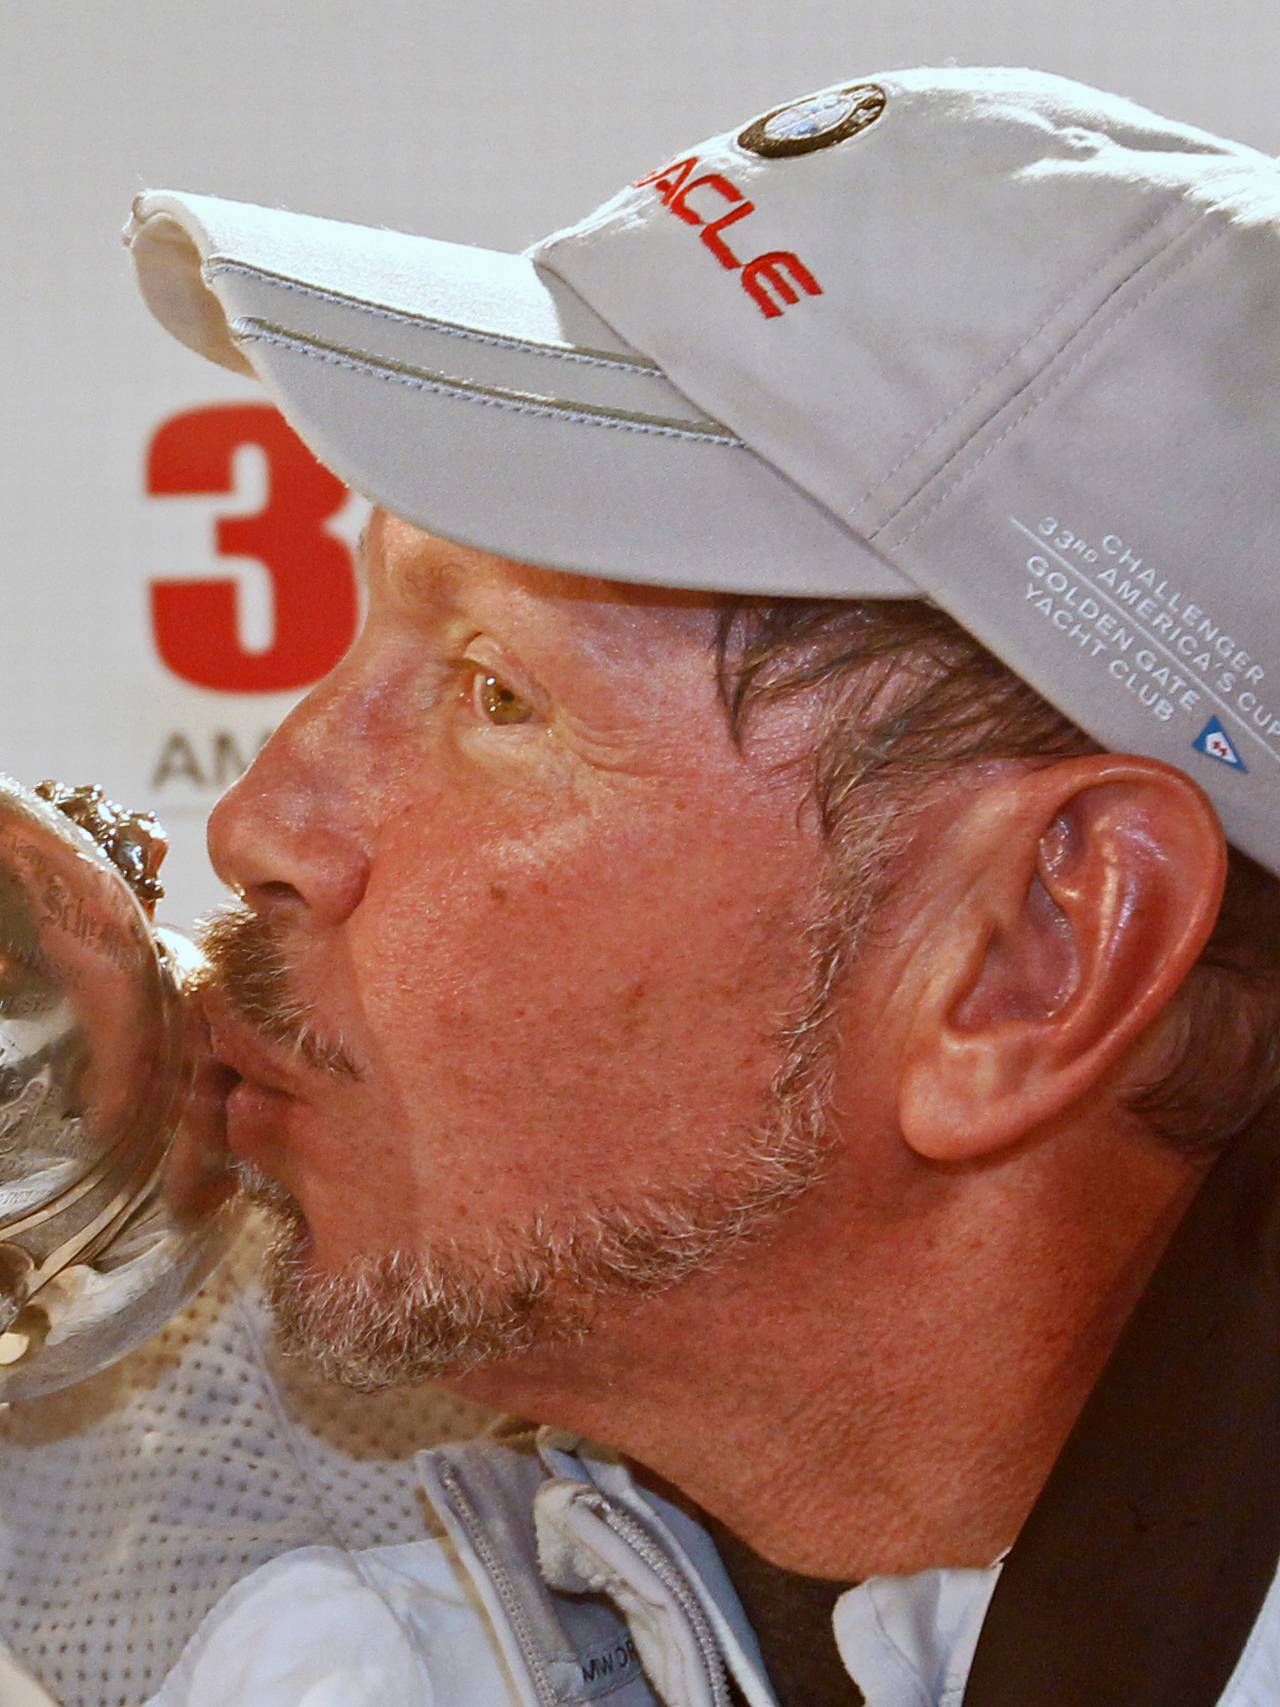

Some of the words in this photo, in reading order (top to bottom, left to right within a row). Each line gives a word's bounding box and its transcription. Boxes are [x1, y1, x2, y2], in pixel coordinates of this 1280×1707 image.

[631, 157, 824, 319] ACLE
[1026, 555, 1135, 652] GOLDEN
[1136, 650, 1201, 711] GATE
[1026, 583, 1105, 658] YACHT
[1109, 660, 1174, 721] CLUB
[1039, 517, 1098, 562] 33RD
[1096, 568, 1236, 692] AMERICA'S
[1102, 534, 1265, 685] CHALLENGER
